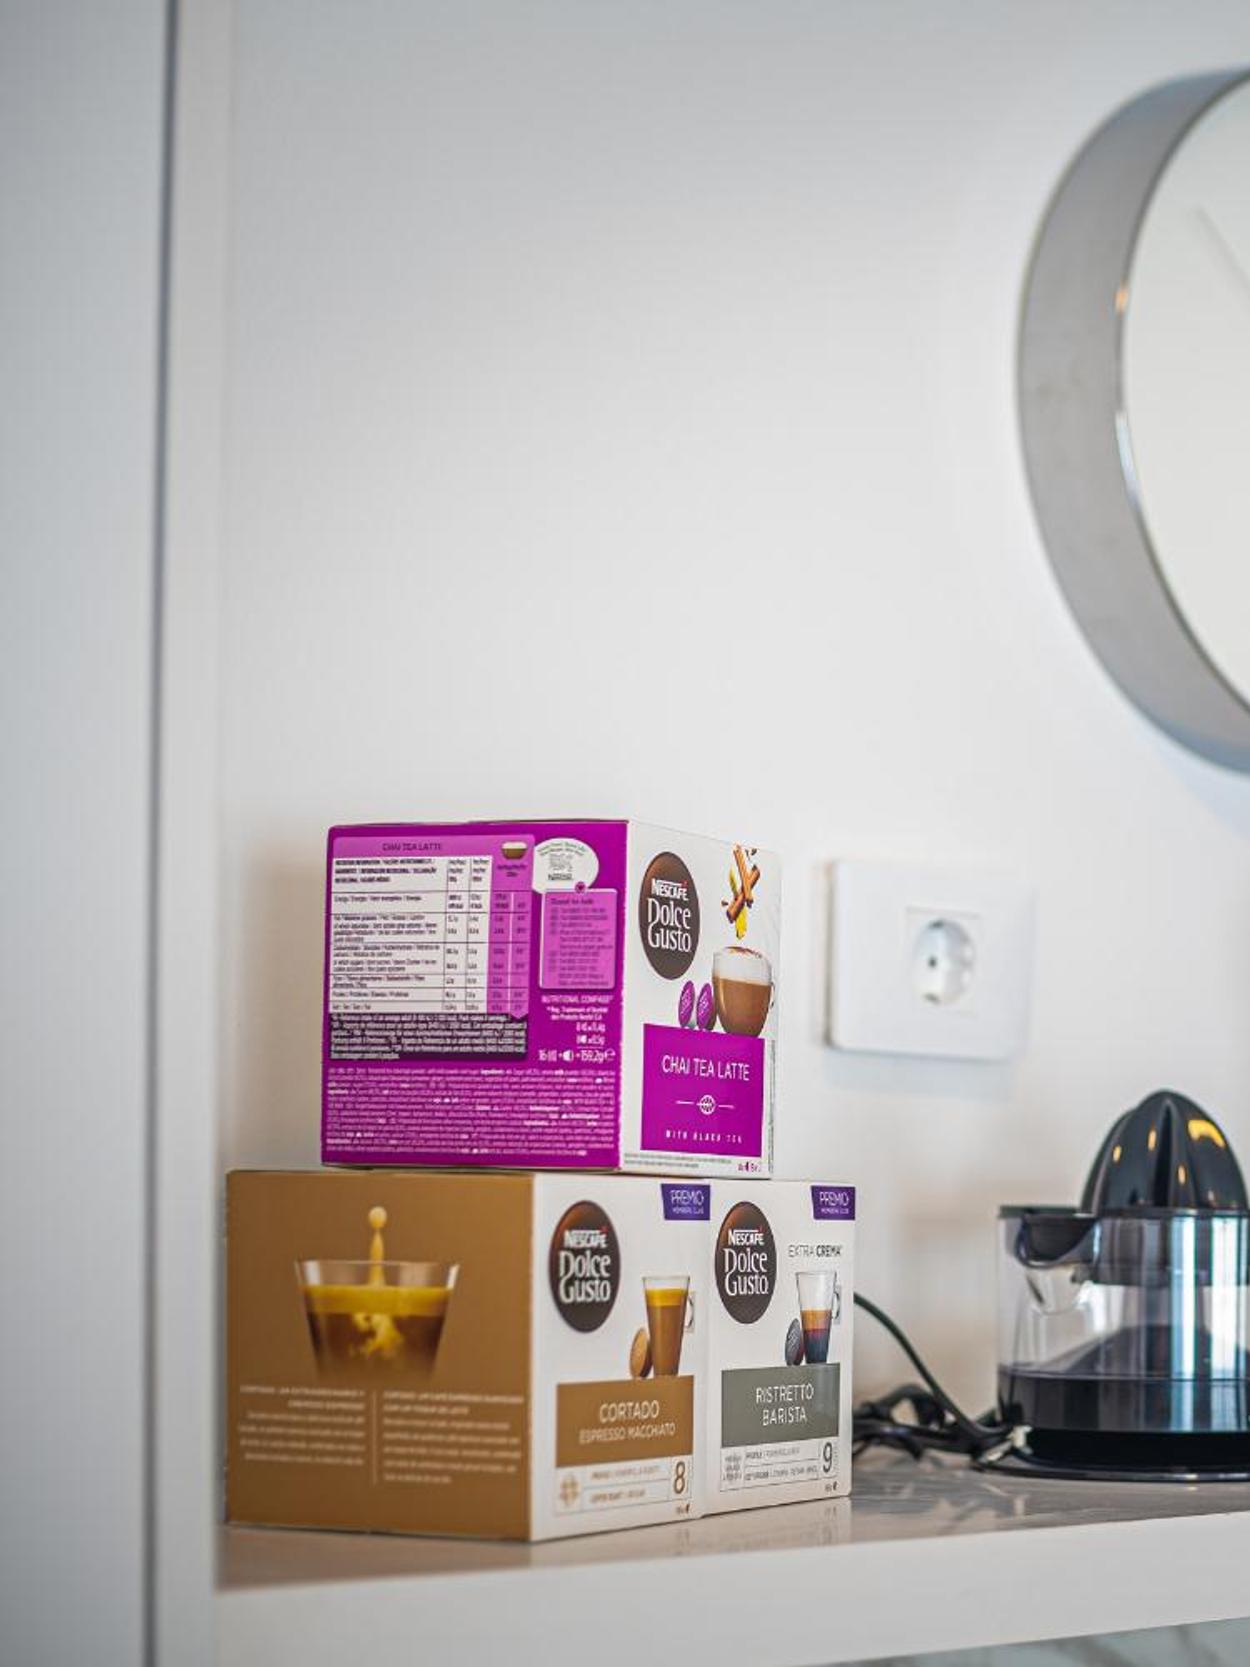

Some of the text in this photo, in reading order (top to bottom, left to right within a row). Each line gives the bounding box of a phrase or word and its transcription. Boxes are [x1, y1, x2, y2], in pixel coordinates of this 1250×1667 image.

[647, 897, 692, 929] Dolce
[647, 922, 693, 953] Gusto
[661, 1054, 750, 1081] CHAI TEA LATTE
[559, 1249, 612, 1278] Dolce
[723, 1247, 768, 1274] Dolce
[788, 1244, 814, 1259] EXTRA
[559, 1273, 612, 1304] Gusto
[724, 1270, 769, 1297] Gusto
[755, 1383, 815, 1404] RISTRETTO
[599, 1400, 660, 1424] CORTADO
[762, 1406, 808, 1426] BARISTA
[579, 1421, 677, 1445] ESPRESSO MACCHIATO
[822, 1441, 834, 1474] 9
[672, 1460, 687, 1495] 8
